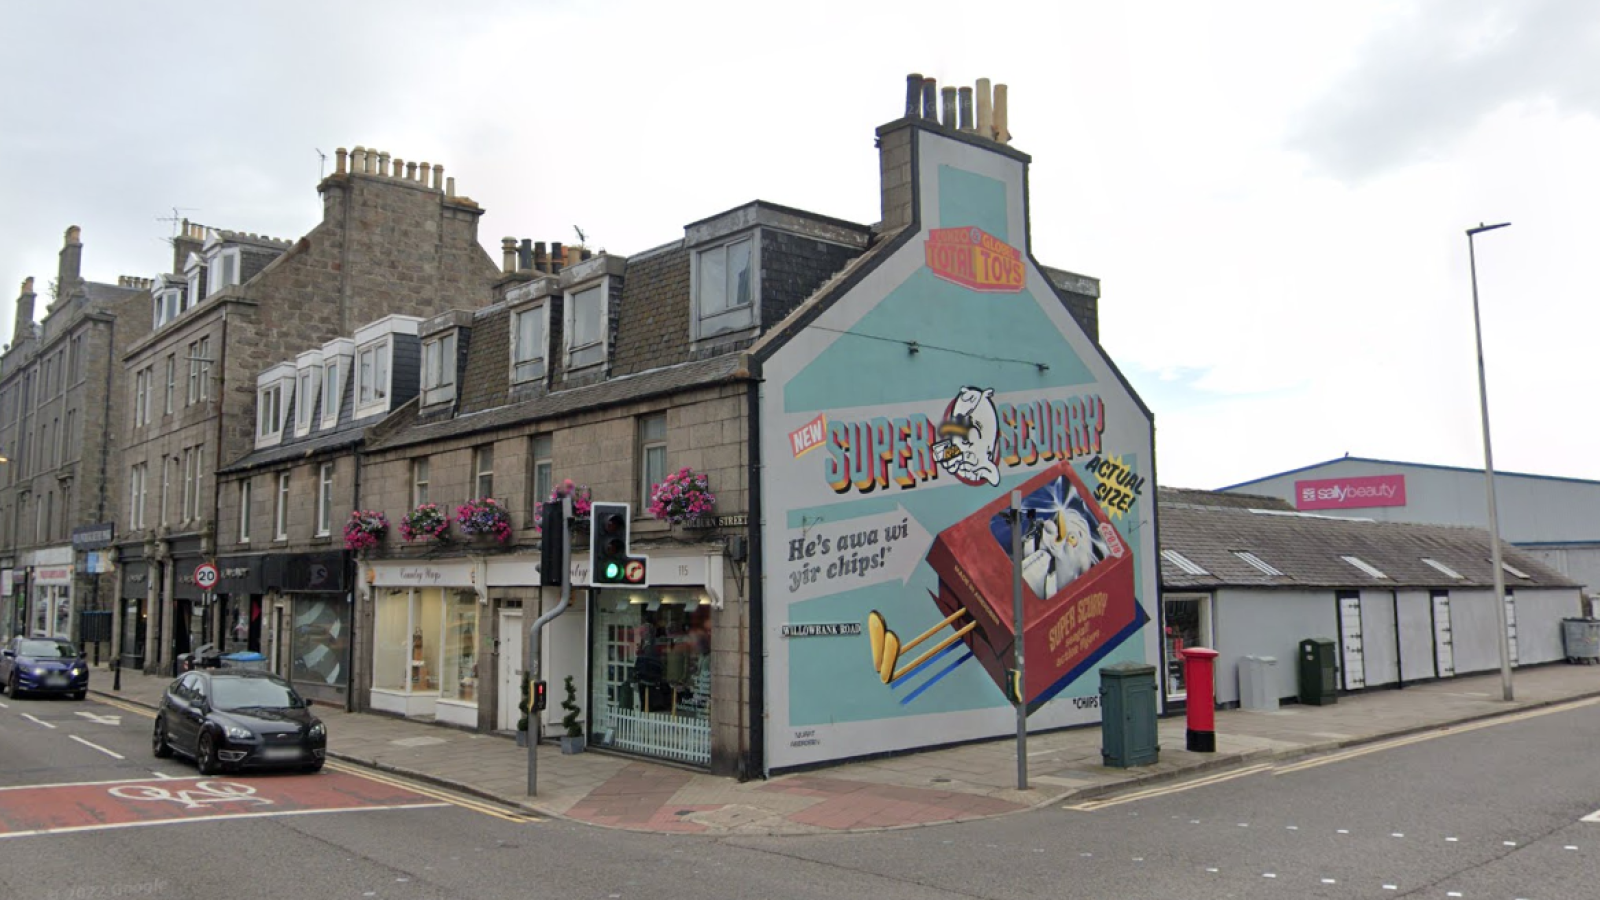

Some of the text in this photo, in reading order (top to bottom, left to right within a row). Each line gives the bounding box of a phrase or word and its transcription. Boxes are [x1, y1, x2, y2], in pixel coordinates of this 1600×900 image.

[981, 250, 1022, 285] TOYS
[793, 420, 823, 453] NEW
[825, 394, 1105, 494] SUPER SCURRY
[1085, 455, 1145, 495] ACTUAL
[1093, 483, 1136, 513] SIZE!
[718, 515, 748, 526] STREET
[788, 517, 908, 562] He's awa wi
[198, 570, 215, 581] 20
[678, 564, 689, 576] 115
[788, 562, 821, 593] yir
[782, 622, 861, 637] WILLOWBANK ROAD
[1049, 605, 1075, 652] SUPER
